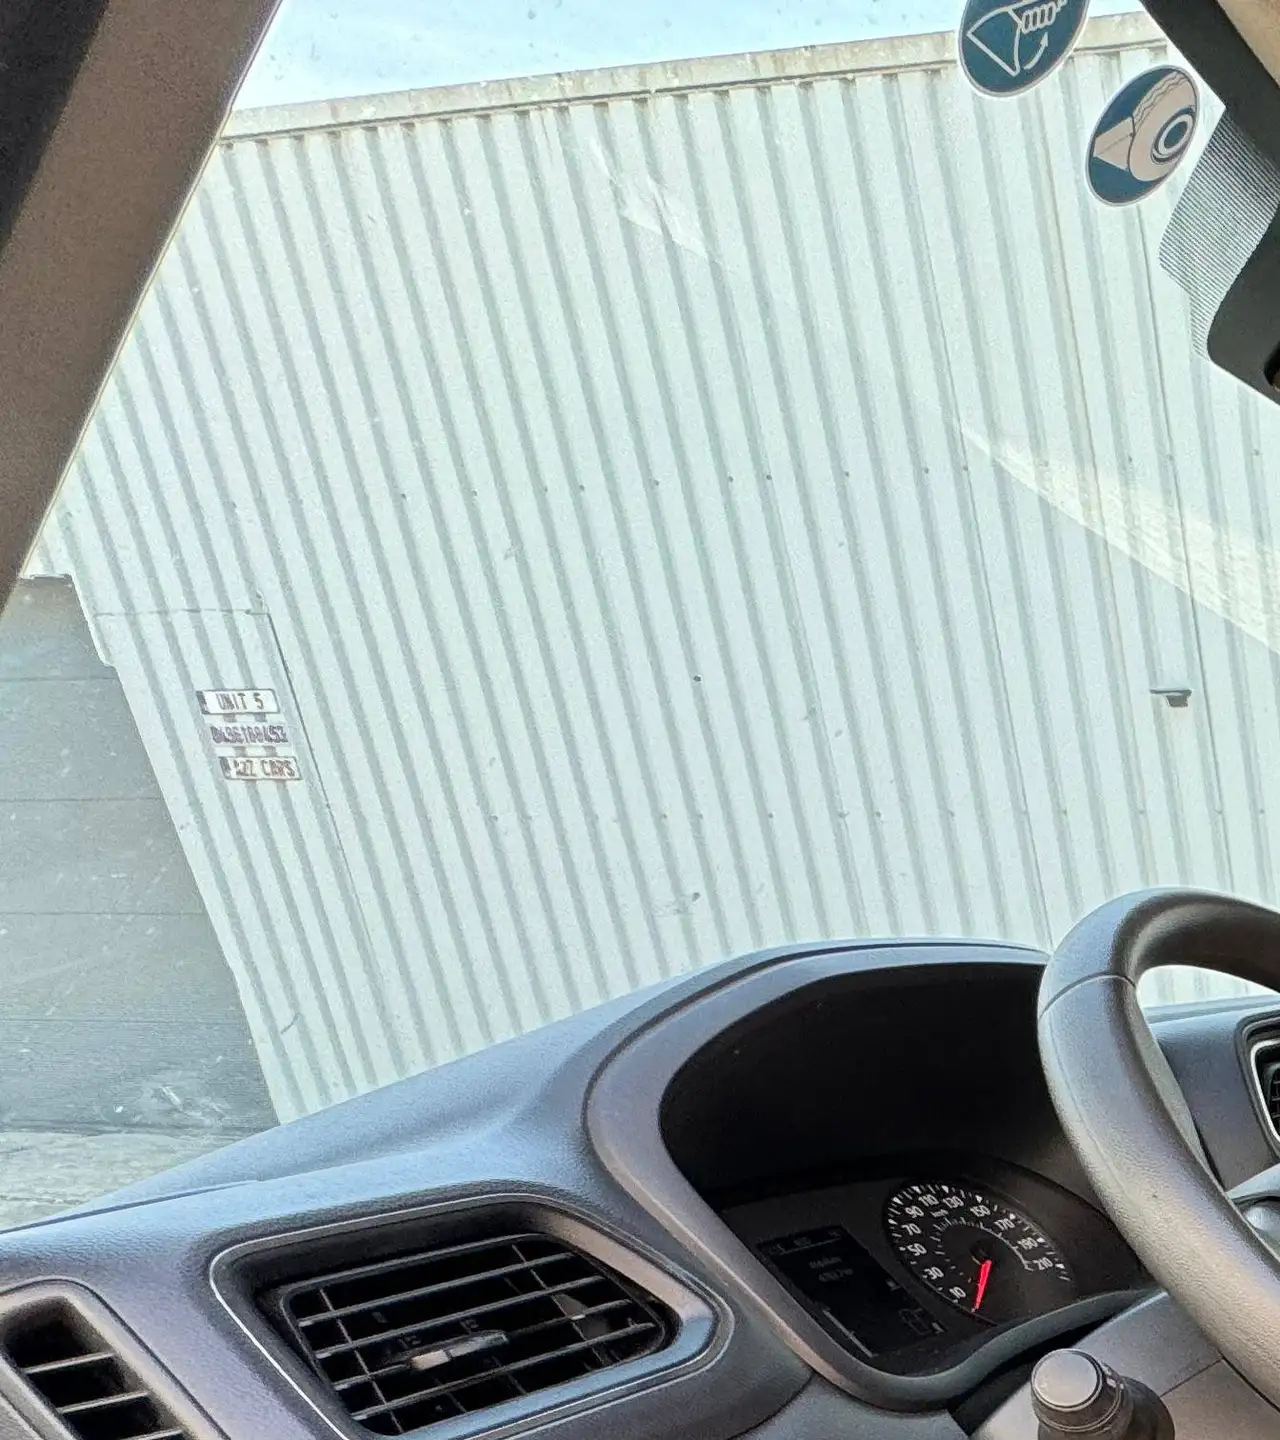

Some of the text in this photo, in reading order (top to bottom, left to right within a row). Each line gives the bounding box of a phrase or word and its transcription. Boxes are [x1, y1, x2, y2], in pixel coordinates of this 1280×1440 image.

[215, 692, 265, 710] UNIT 5
[918, 1193, 940, 1208] 110
[942, 1195, 965, 1209] 130
[904, 1204, 925, 1219] 90
[969, 1204, 991, 1218] 150
[901, 1222, 922, 1236] 70
[995, 1217, 1016, 1231] 170
[906, 1242, 927, 1257] 50
[1033, 1257, 1054, 1271] 210
[925, 1265, 945, 1281] 30
[949, 1286, 967, 1299] 10
